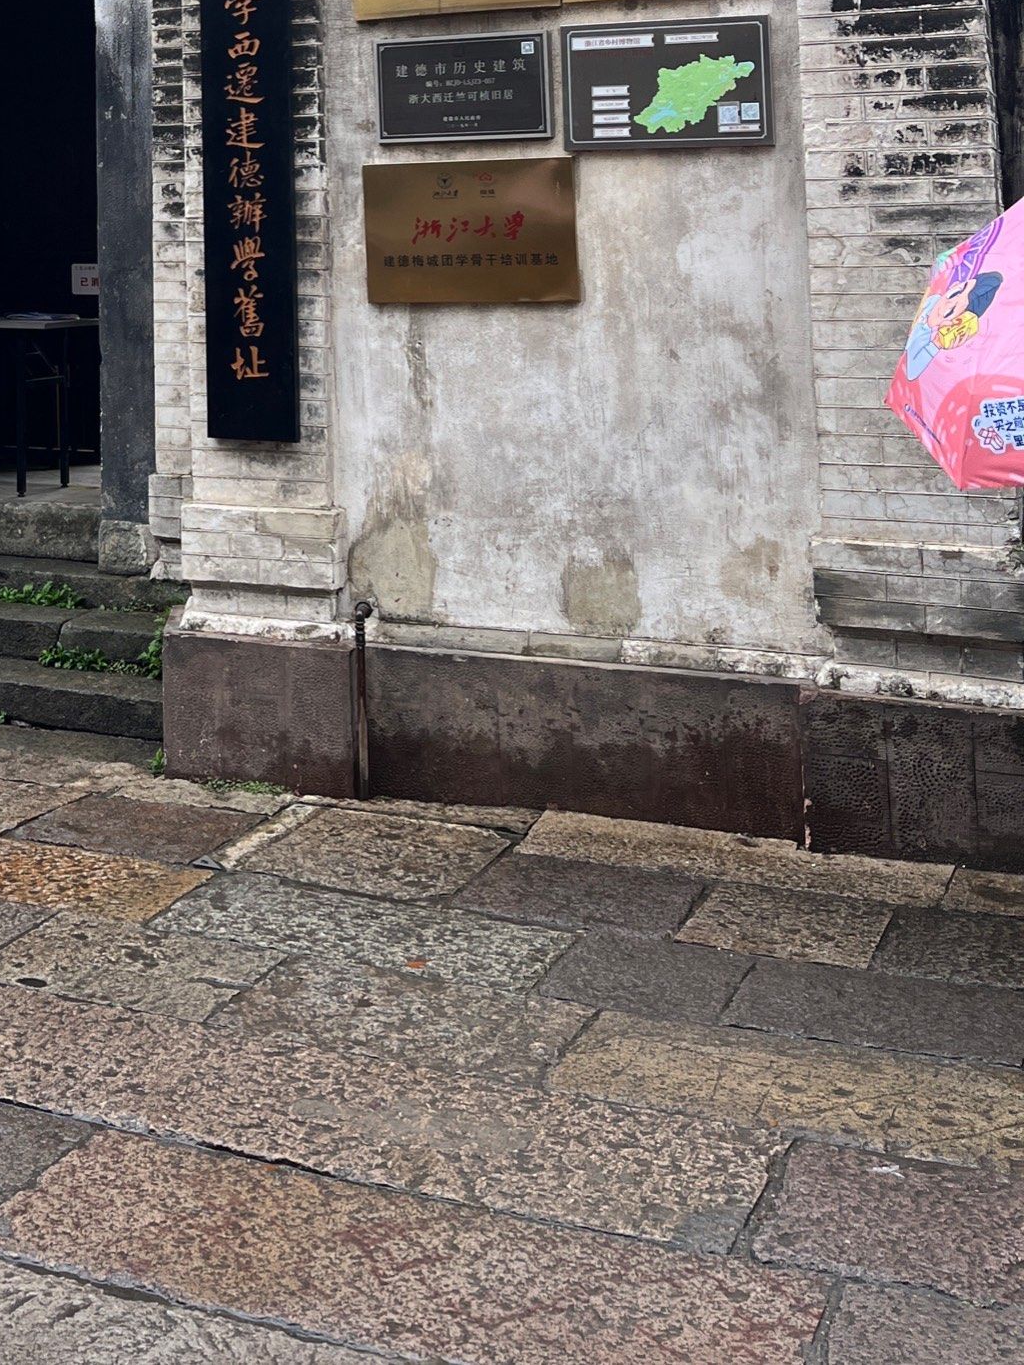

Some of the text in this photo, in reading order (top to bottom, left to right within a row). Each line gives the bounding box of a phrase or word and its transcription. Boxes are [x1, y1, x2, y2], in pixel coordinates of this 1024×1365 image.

[395, 57, 527, 78] 建德市历史建筑
[383, 252, 559, 268] 建德梅城团学骨干培训基地
[993, 416, 1024, 432] 买之前
